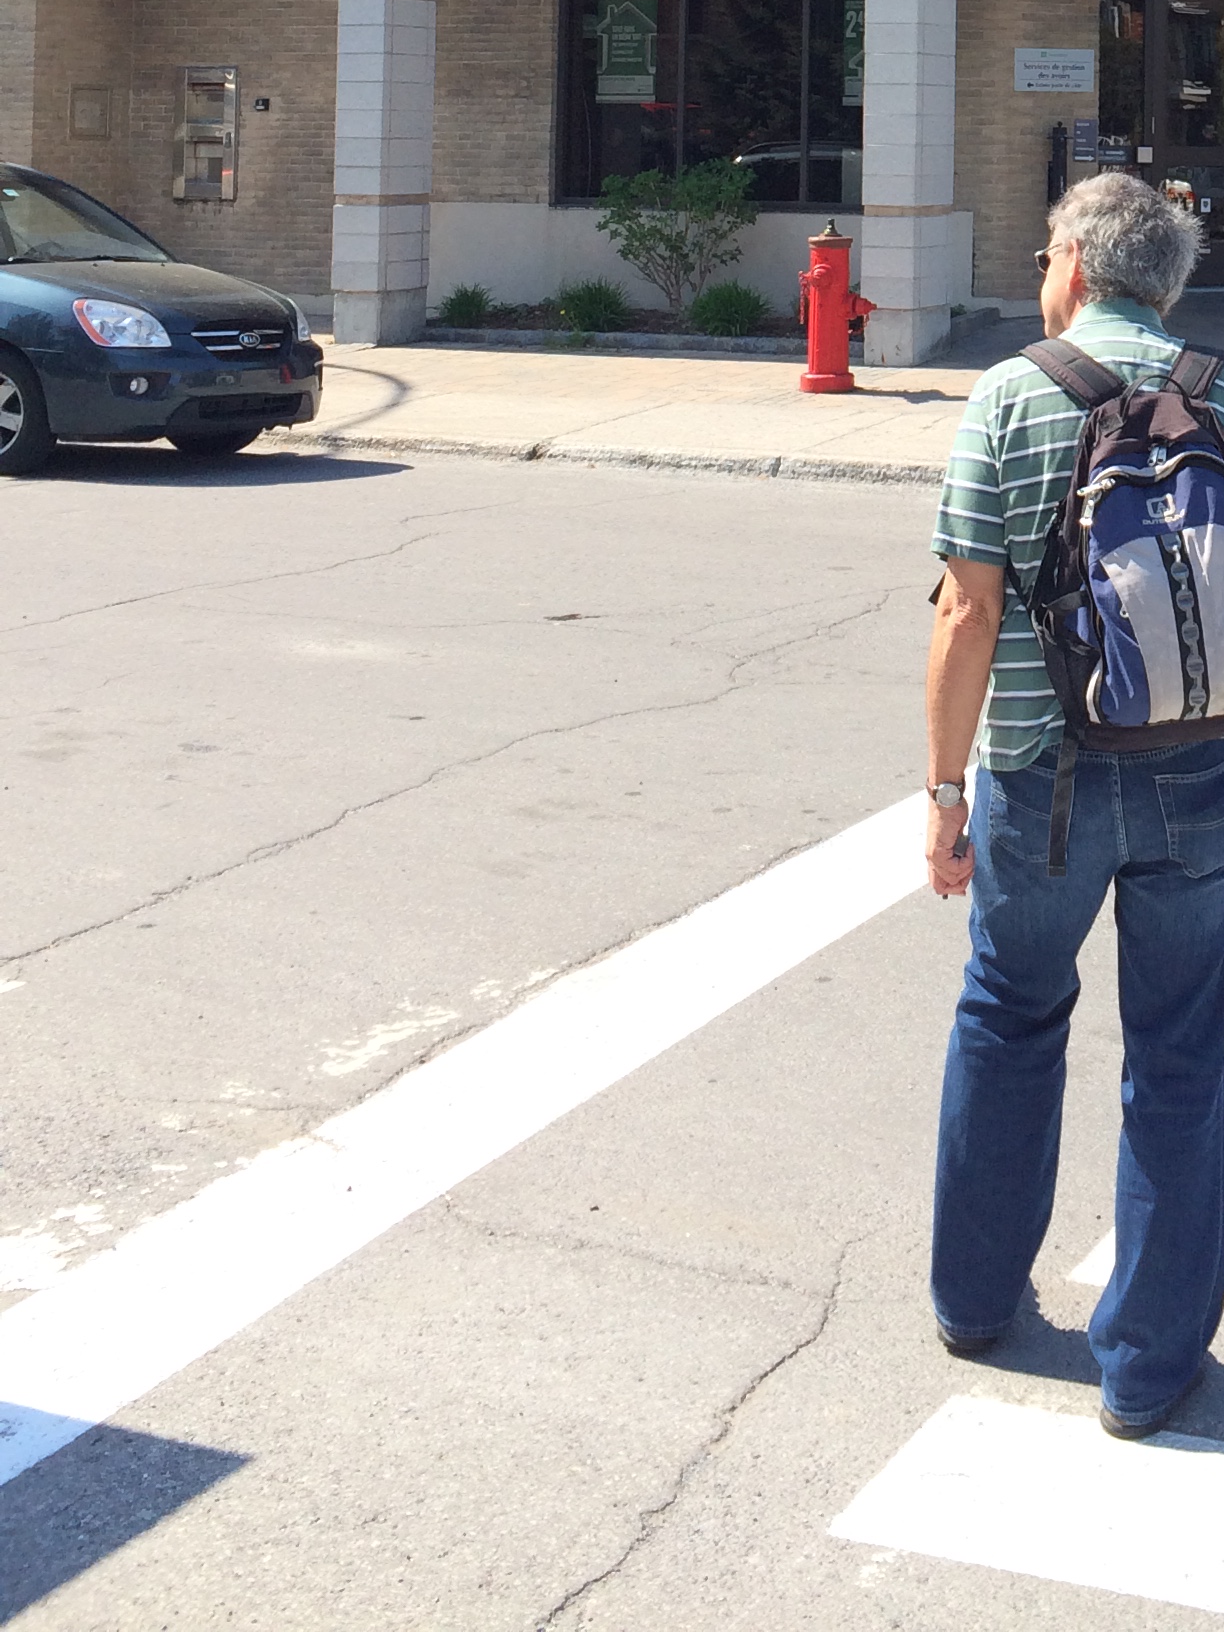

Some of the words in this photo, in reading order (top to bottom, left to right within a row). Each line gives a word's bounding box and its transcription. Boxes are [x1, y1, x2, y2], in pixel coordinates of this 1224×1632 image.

[1023, 62, 1051, 71] Services
[1052, 63, 1060, 71] de
[243, 335, 258, 344] KIA
